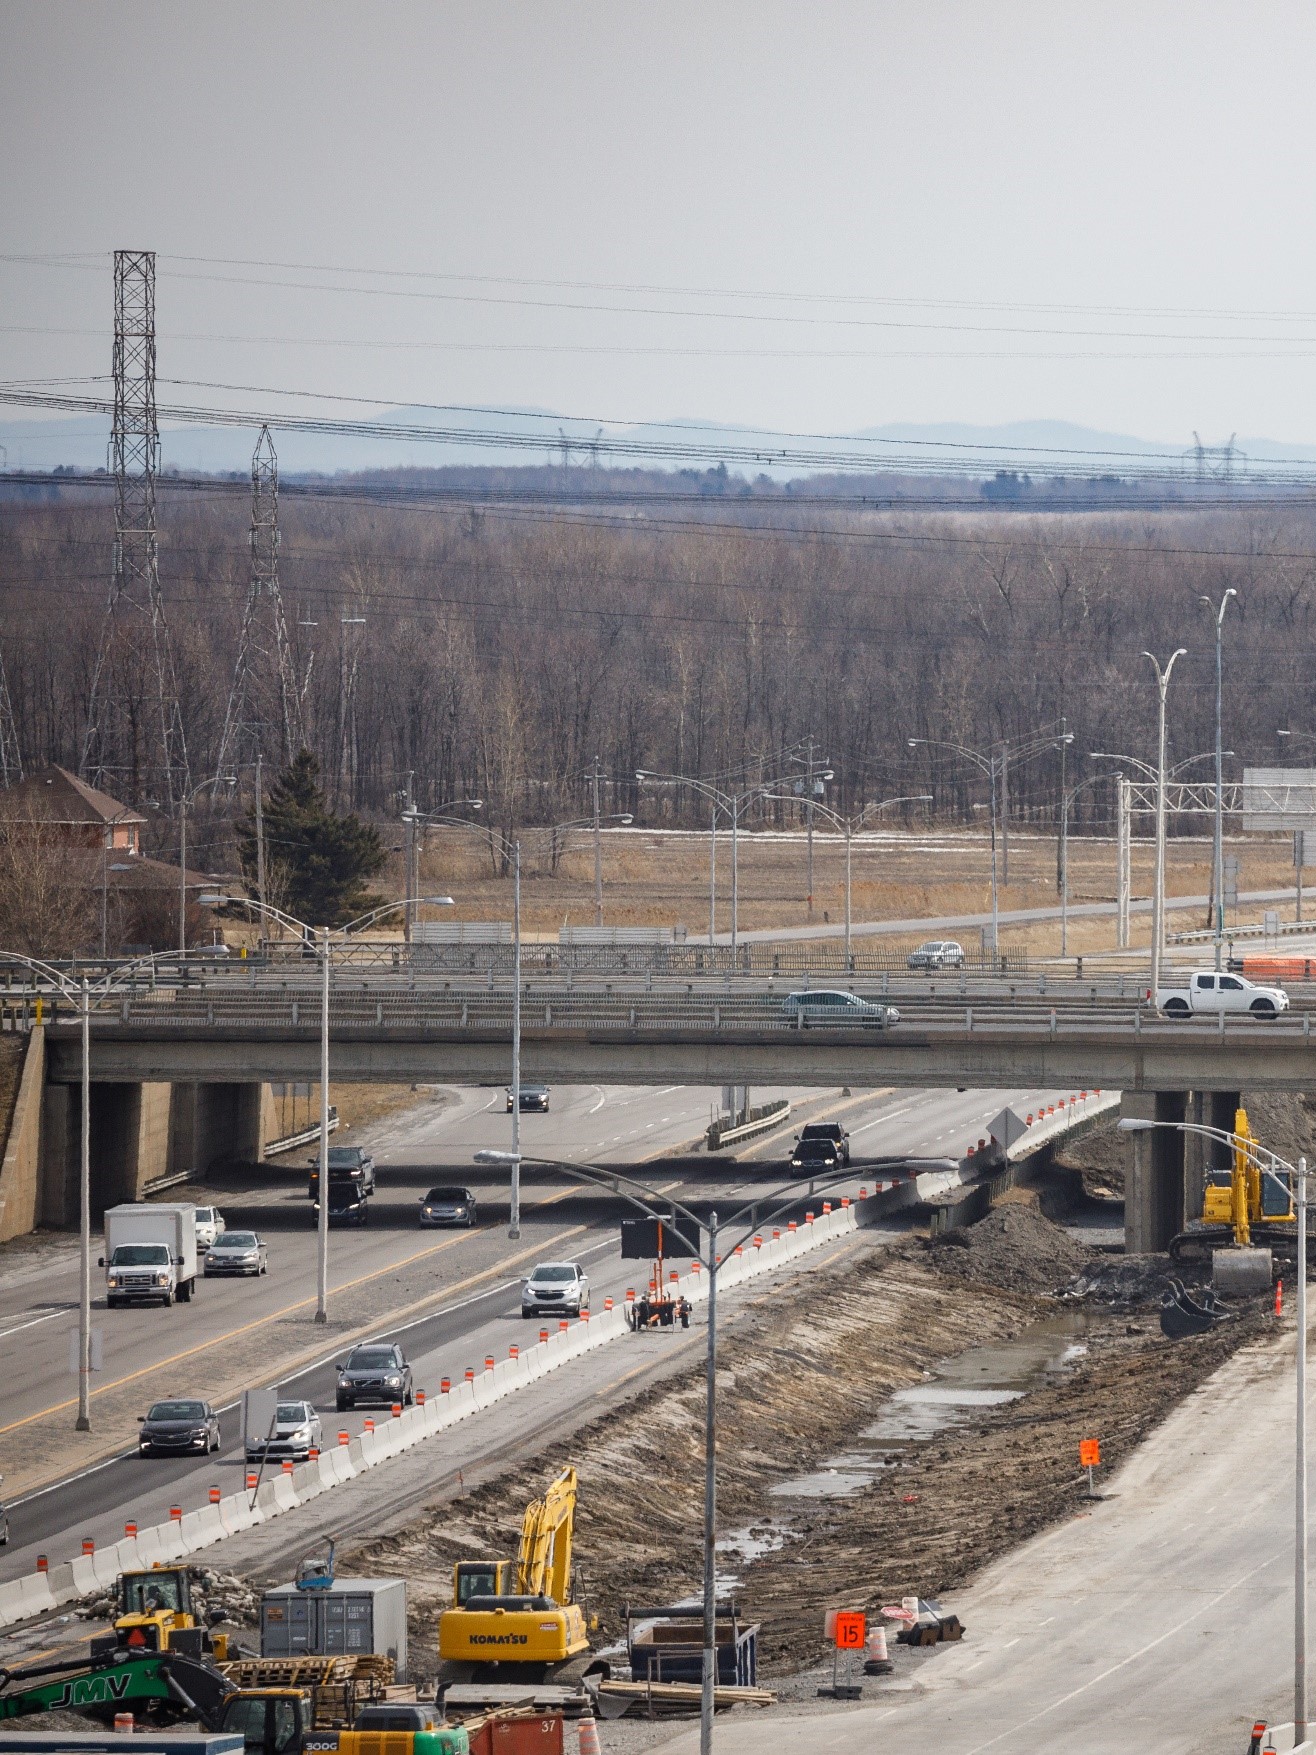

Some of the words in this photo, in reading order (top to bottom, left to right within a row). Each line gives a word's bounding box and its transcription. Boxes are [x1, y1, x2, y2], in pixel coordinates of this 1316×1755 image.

[469, 1632, 528, 1645] KOMATSU
[843, 1625, 859, 1643] 15
[48, 1672, 133, 1710] JMV
[541, 1719, 556, 1733] 37
[305, 1742, 338, 1751] 300G
